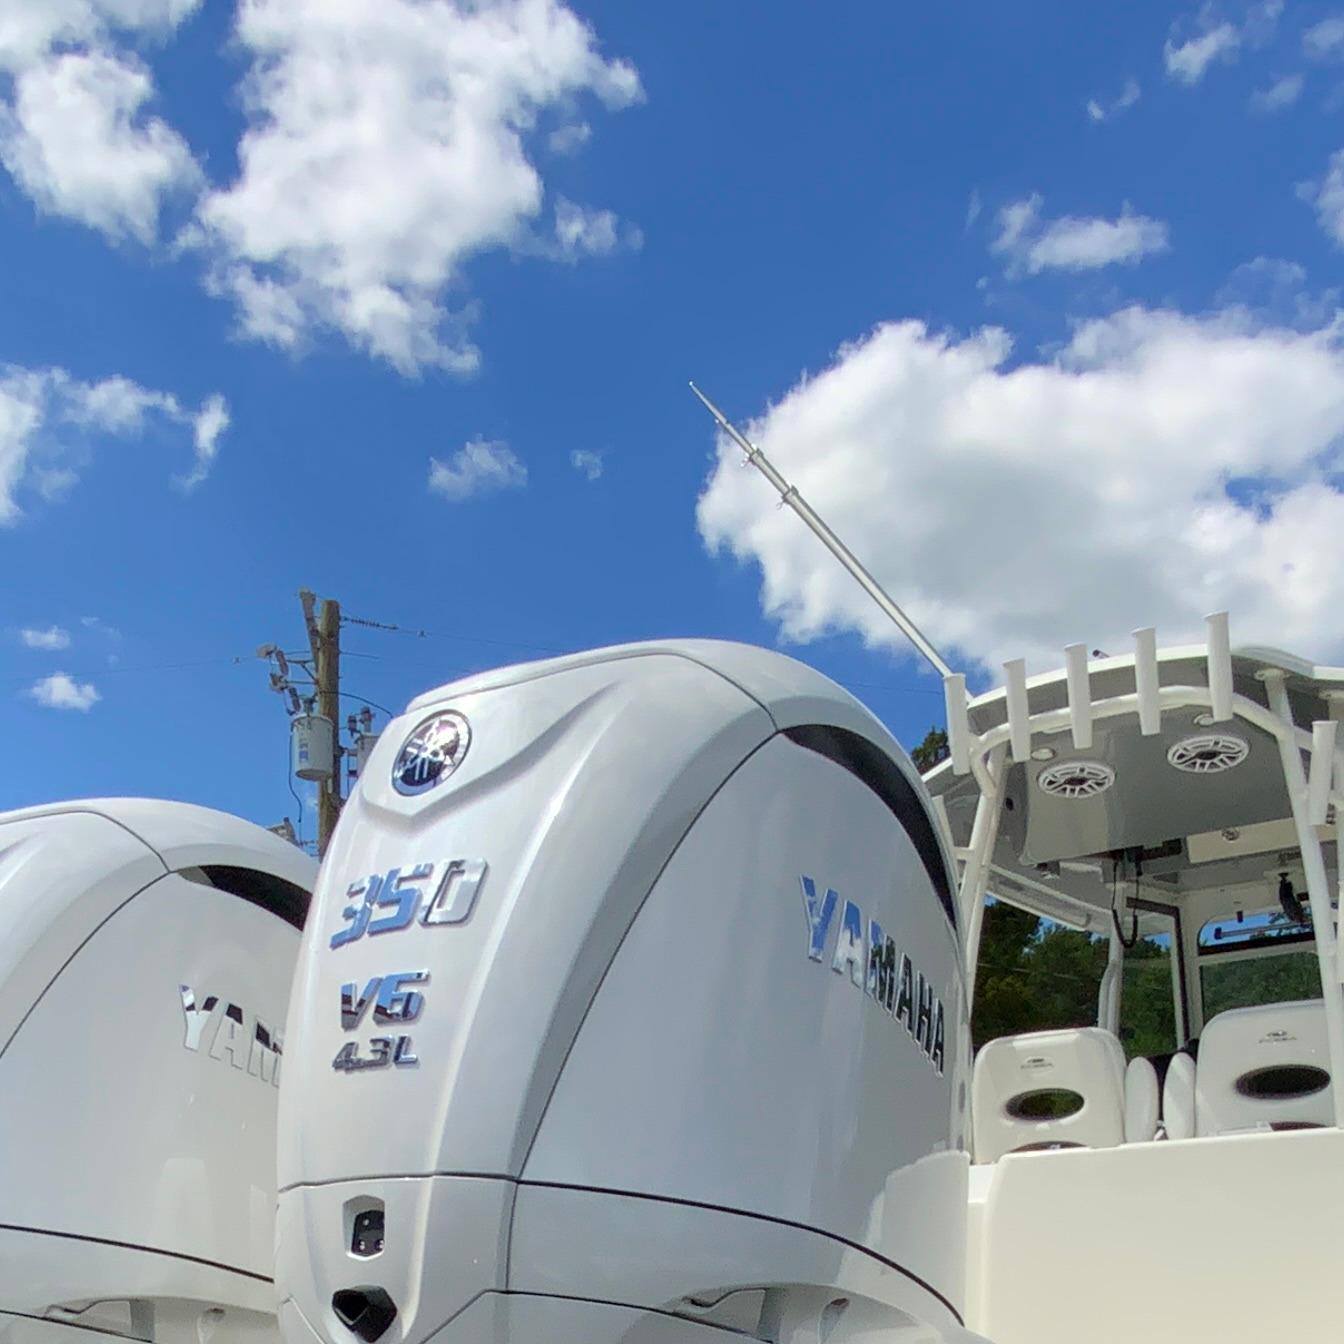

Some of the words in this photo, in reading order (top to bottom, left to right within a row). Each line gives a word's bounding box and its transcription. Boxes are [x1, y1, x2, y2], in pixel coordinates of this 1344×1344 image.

[329, 857, 489, 950] 350
[340, 968, 430, 1031] V6
[800, 874, 944, 1078] YAMAHA
[332, 1033, 420, 1074] 4.3L
